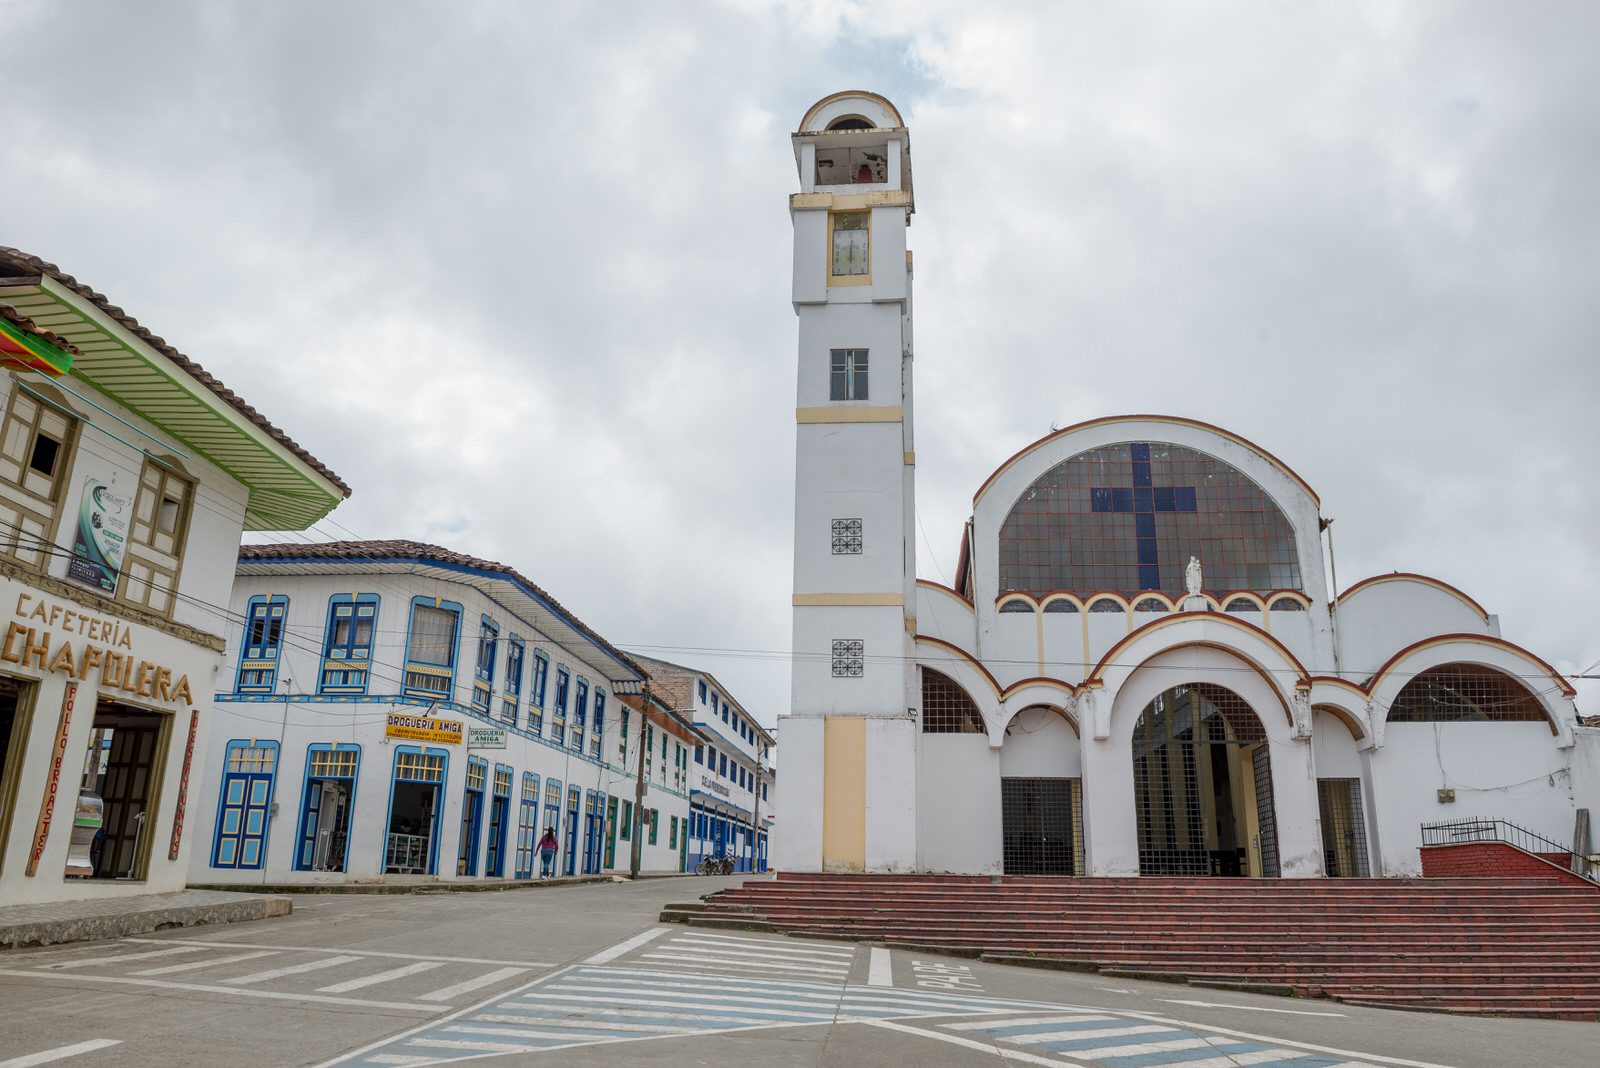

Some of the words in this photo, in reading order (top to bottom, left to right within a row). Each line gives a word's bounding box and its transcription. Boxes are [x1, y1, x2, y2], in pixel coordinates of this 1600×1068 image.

[1, 621, 193, 706] CHAPOLERA
[60, 687, 76, 749] POLLO
[388, 715, 435, 731] DROGUERIA
[438, 721, 462, 734] AMIGA
[34, 757, 62, 861] BROASTER
[173, 716, 198, 853] DESAYUNOS
